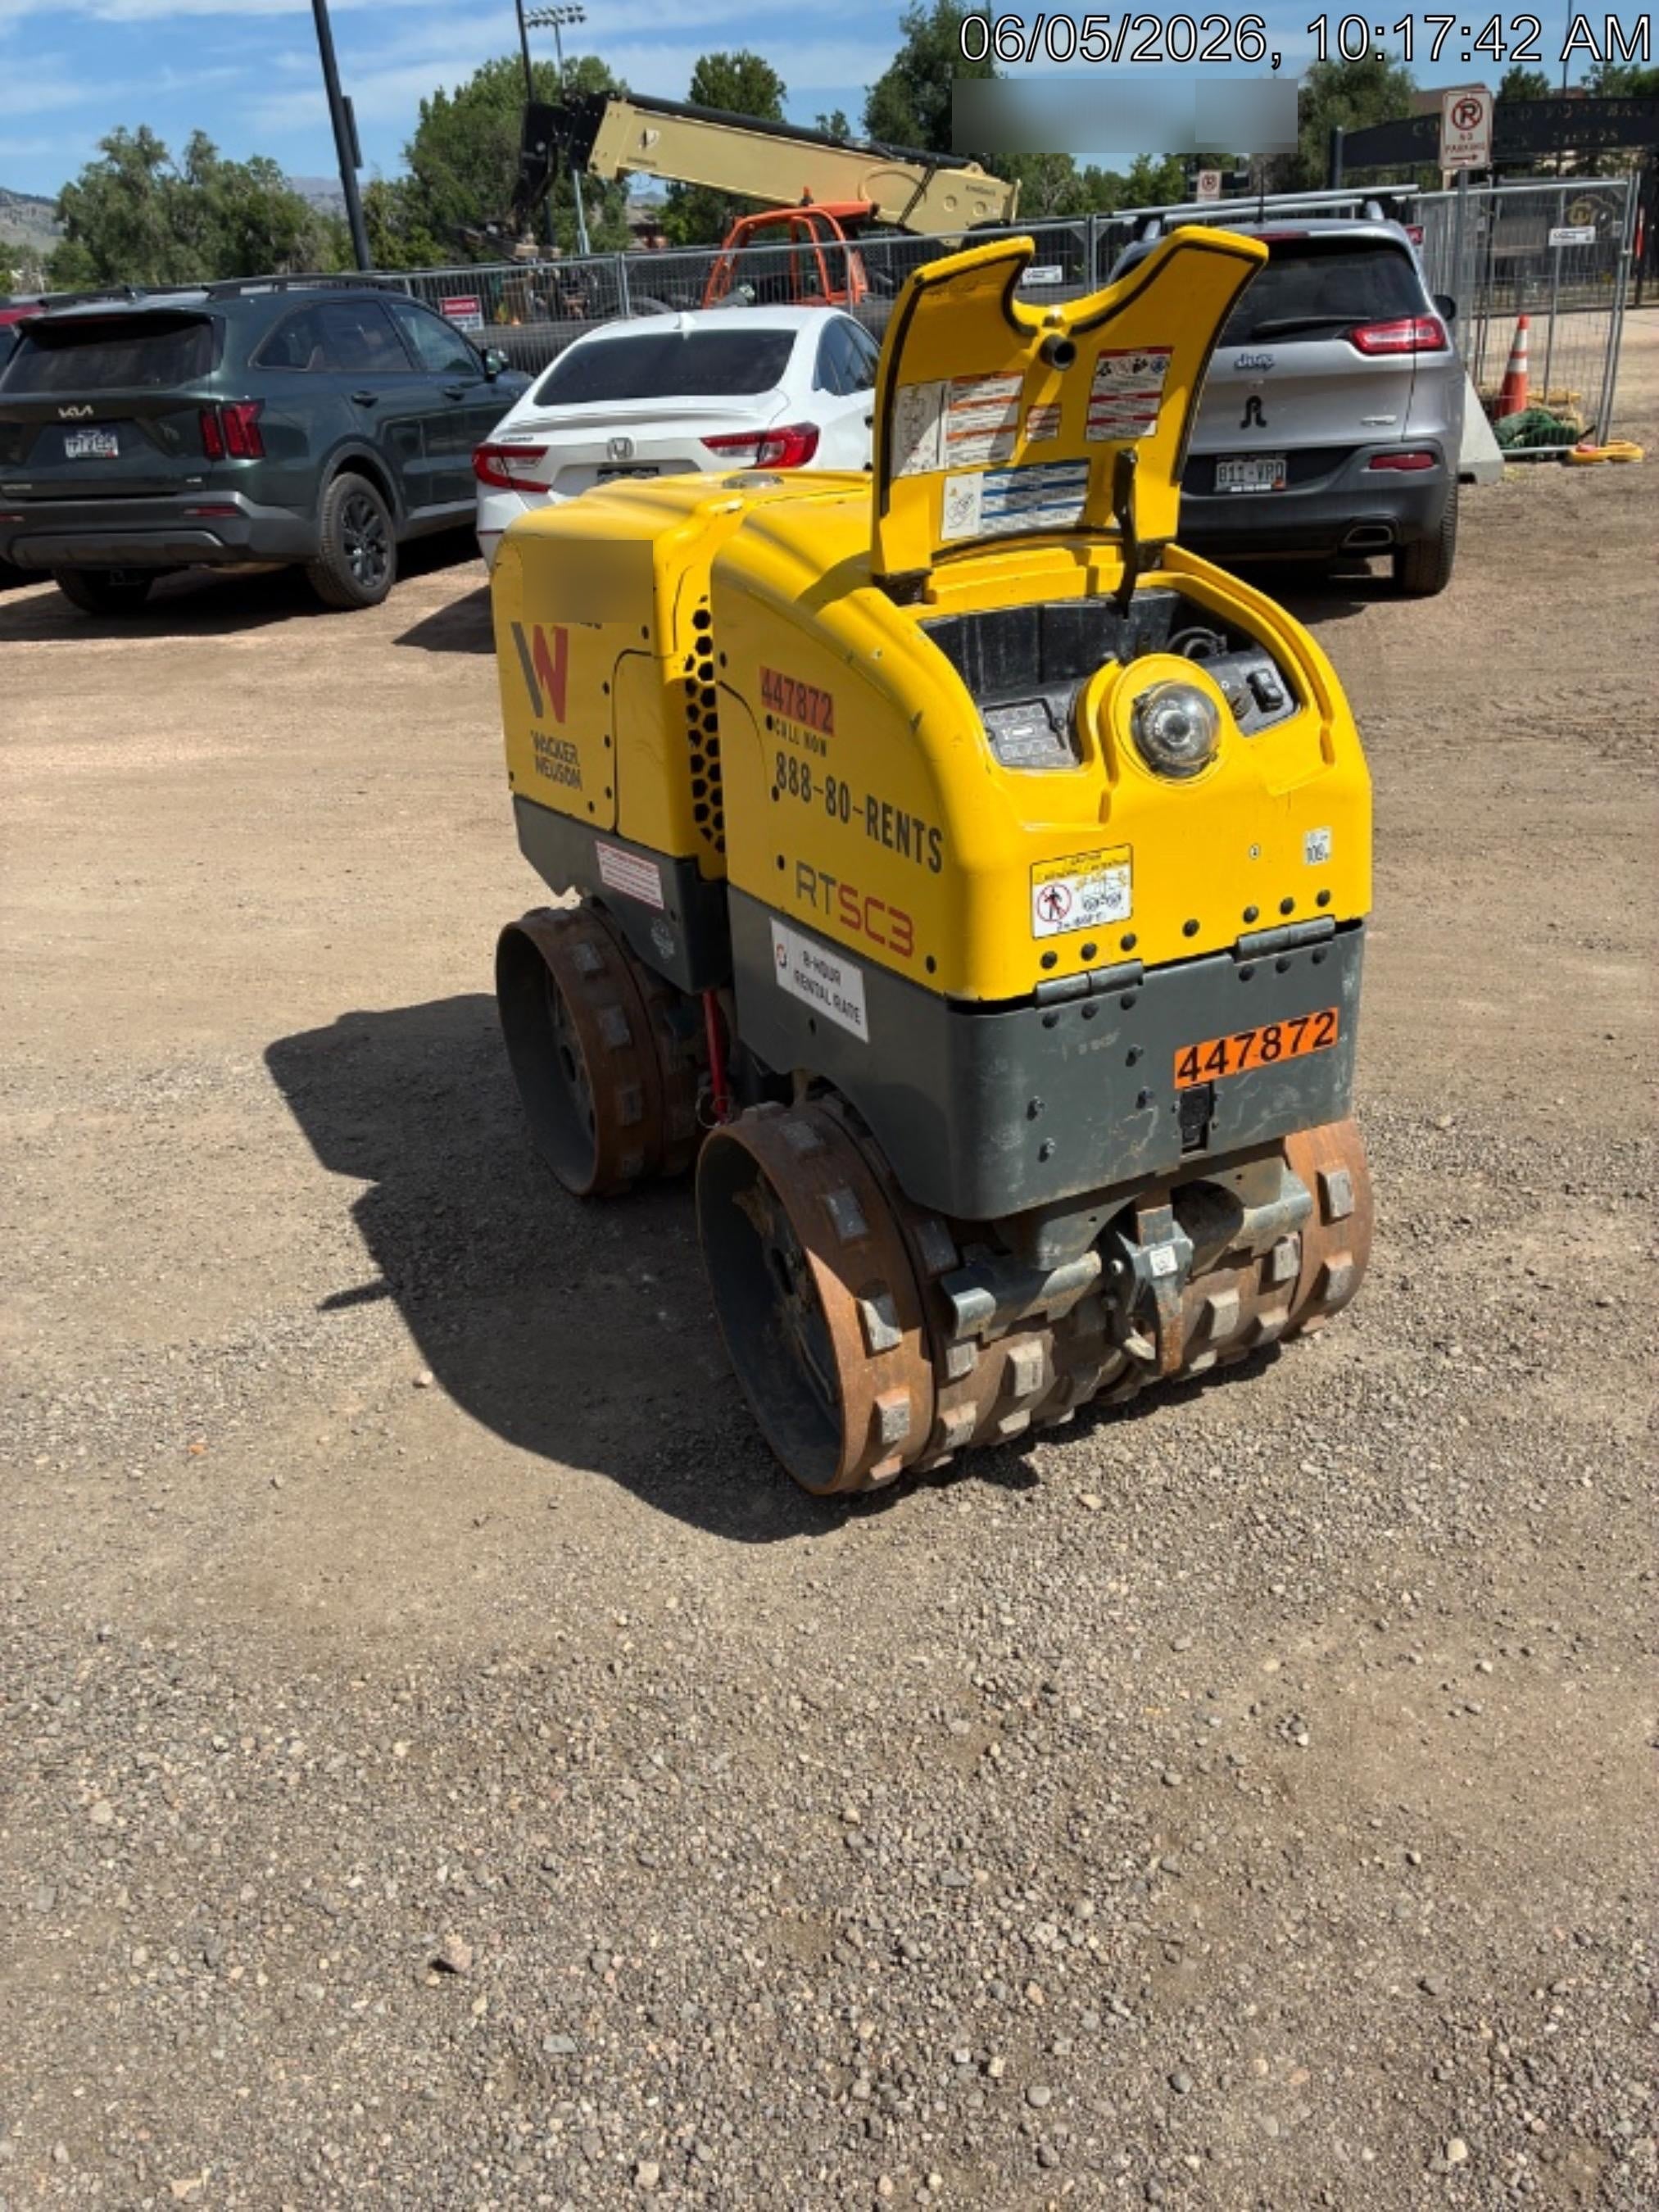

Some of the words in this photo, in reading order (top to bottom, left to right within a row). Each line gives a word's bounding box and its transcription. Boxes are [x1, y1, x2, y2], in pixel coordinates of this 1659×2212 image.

[761, 669, 834, 732] 447872
[531, 729, 580, 768] WACKER
[774, 718, 800, 746] CALL
[804, 732, 827, 758] NOW
[535, 755, 582, 792] NEUSON
[776, 750, 943, 874] 888-80-RENTS
[796, 860, 915, 958] RTSC3
[794, 969, 832, 1007] RENTAL
[833, 993, 861, 1025] RATE
[1177, 1012, 1335, 1082] 447872
